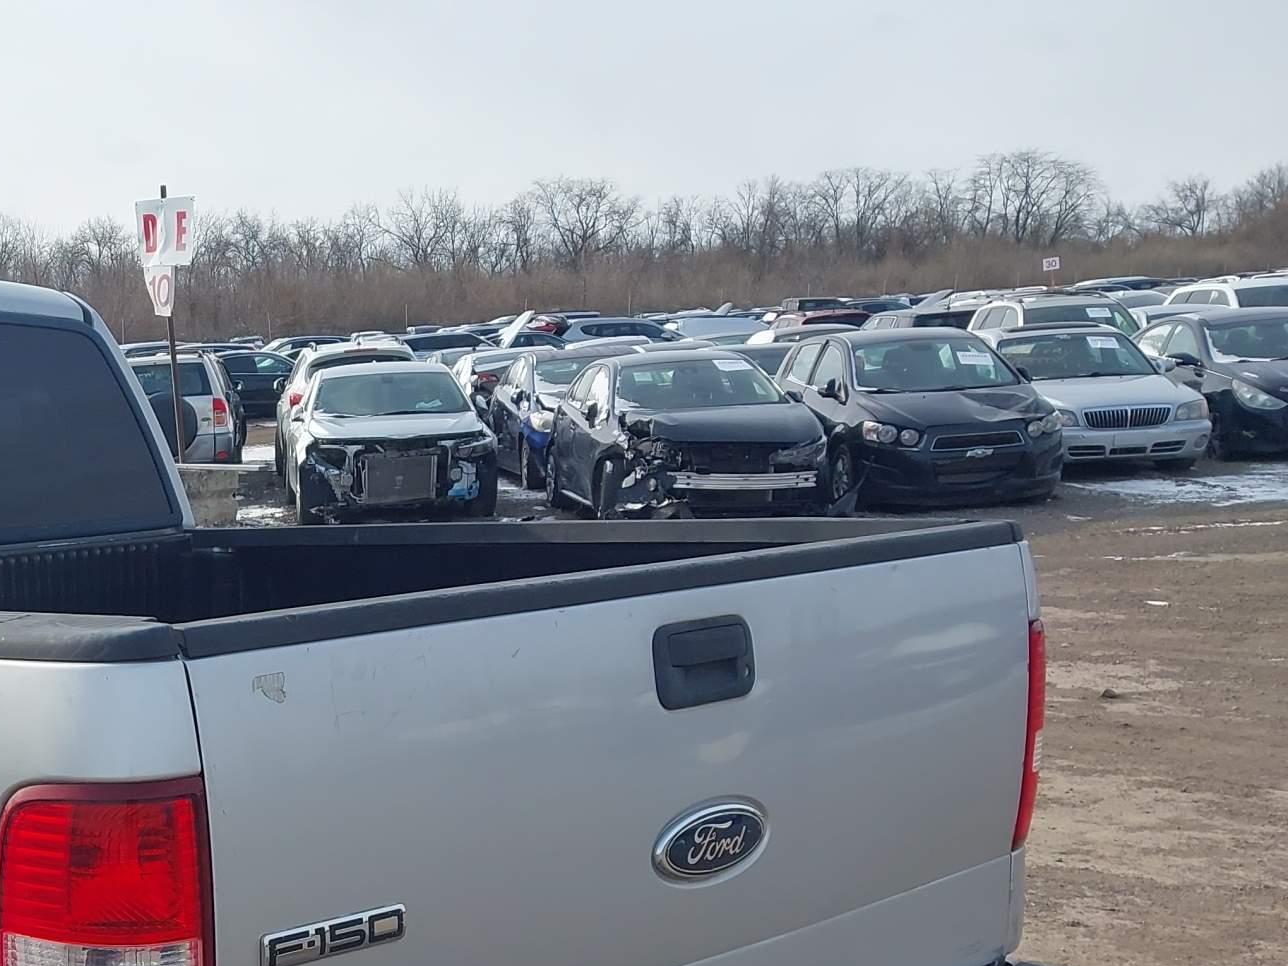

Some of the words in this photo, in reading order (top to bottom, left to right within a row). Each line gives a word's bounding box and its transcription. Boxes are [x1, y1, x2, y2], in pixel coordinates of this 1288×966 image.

[142, 213, 158, 254] D
[175, 210, 187, 252] E
[1045, 259, 1057, 269] 30
[152, 273, 173, 308] 10
[687, 820, 747, 865] Ford
